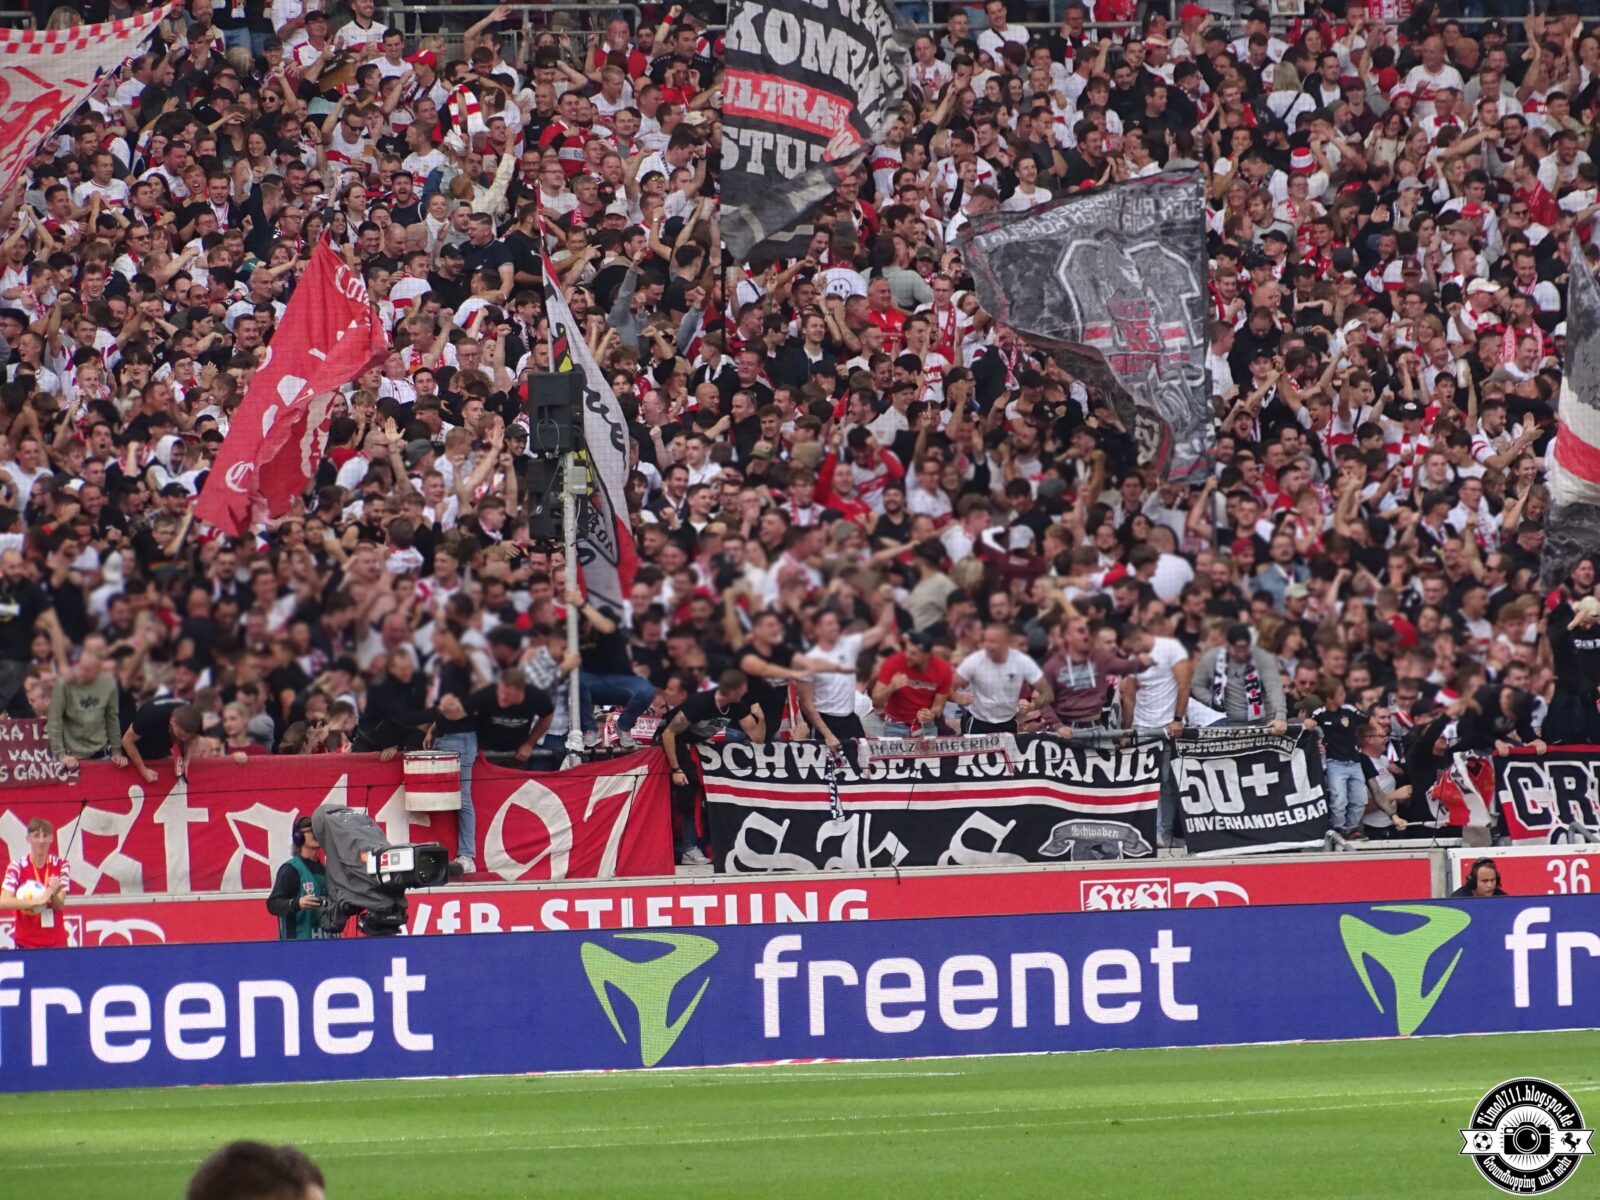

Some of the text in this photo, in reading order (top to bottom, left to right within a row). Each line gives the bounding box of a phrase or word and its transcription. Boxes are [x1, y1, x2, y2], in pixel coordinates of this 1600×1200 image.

[1236, 727, 1275, 738] ALLE
[696, 740, 1163, 782] SCHWABEN KOMPANIE
[1171, 748, 1324, 815] 50+1
[1185, 799, 1329, 833] UNVERHANDELBAR
[1503, 761, 1600, 831] CR
[1071, 825, 1119, 838] Schwaben
[755, 934, 1198, 1038] freenet
